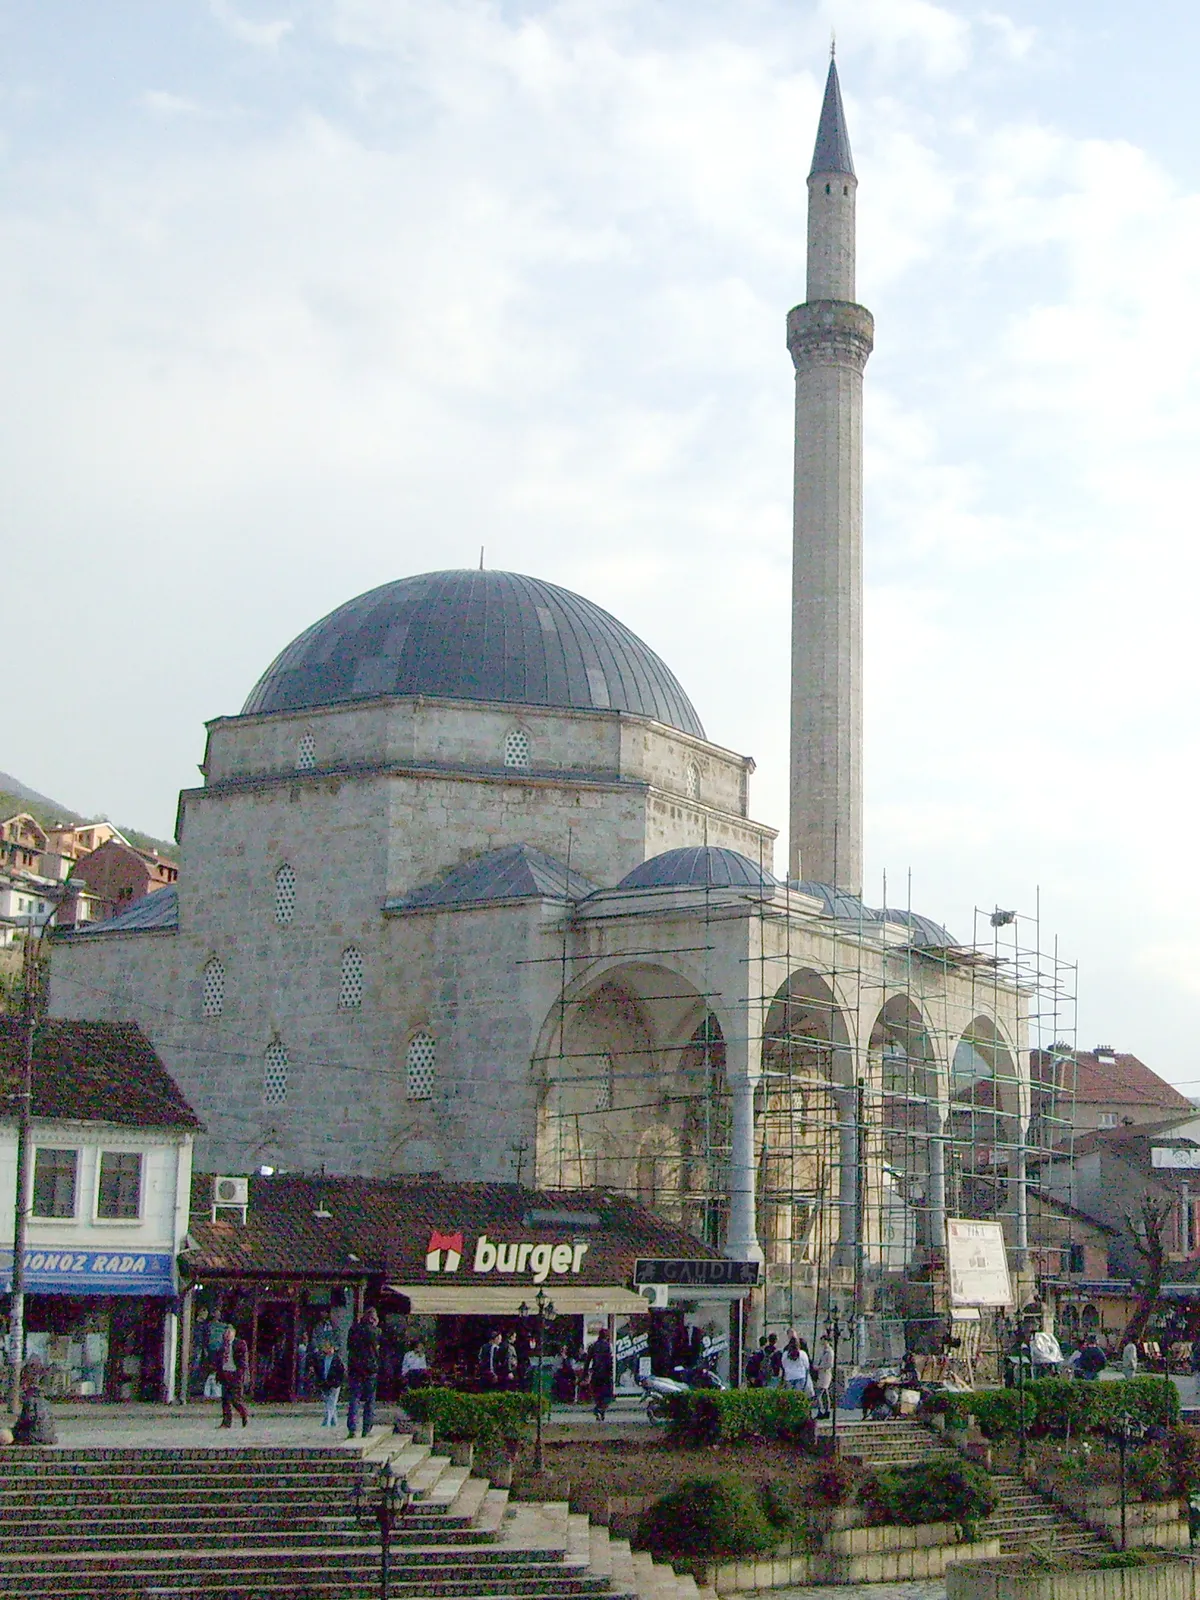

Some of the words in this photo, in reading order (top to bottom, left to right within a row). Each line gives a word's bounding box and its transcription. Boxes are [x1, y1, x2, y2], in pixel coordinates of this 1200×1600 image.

[90, 1255, 146, 1273] RADA
[474, 1234, 588, 1284] burger
[663, 1261, 732, 1281] GAUDI
[616, 1335, 632, 1352] 25
